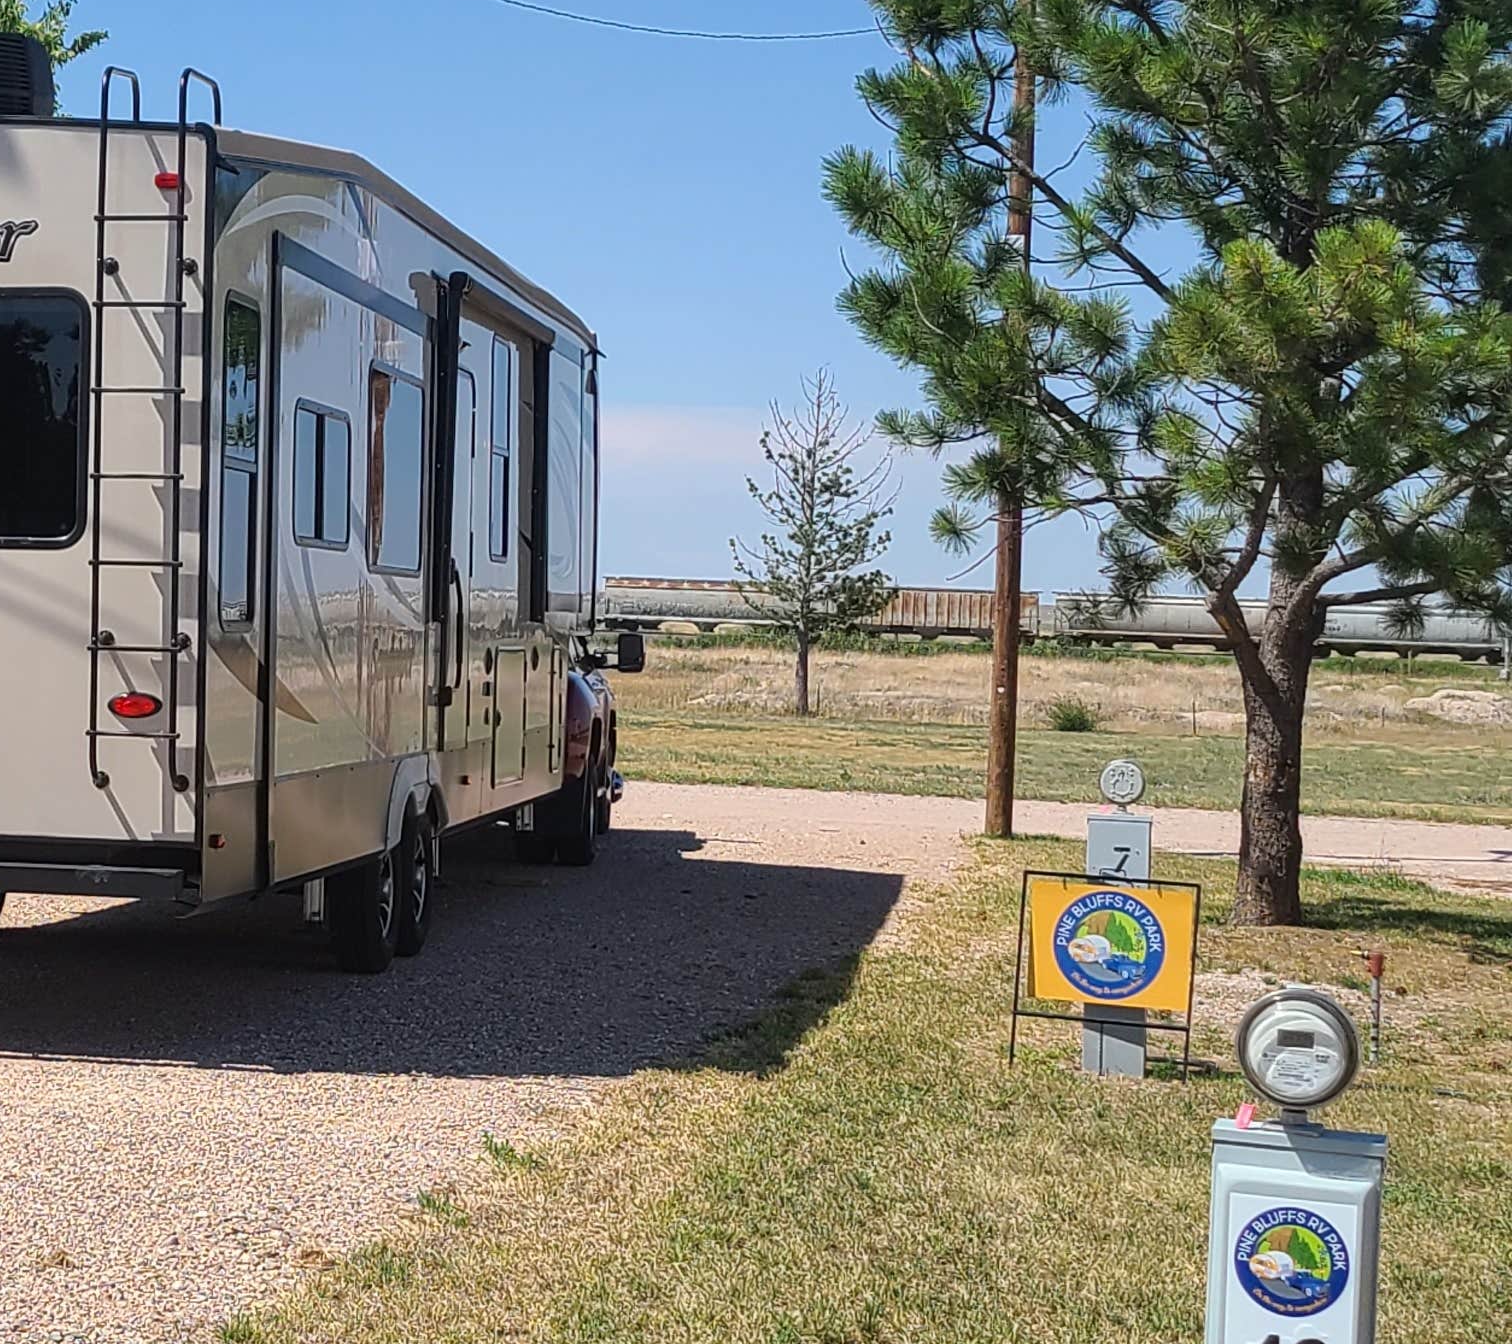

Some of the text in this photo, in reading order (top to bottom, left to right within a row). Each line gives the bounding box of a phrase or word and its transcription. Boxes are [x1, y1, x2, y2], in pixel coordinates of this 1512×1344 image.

[1113, 846, 1131, 873] 7
[1056, 894, 1162, 953] PINE BLUFFS RV PARK
[1237, 1210, 1348, 1271] PINE BLUFFS RV PARK
